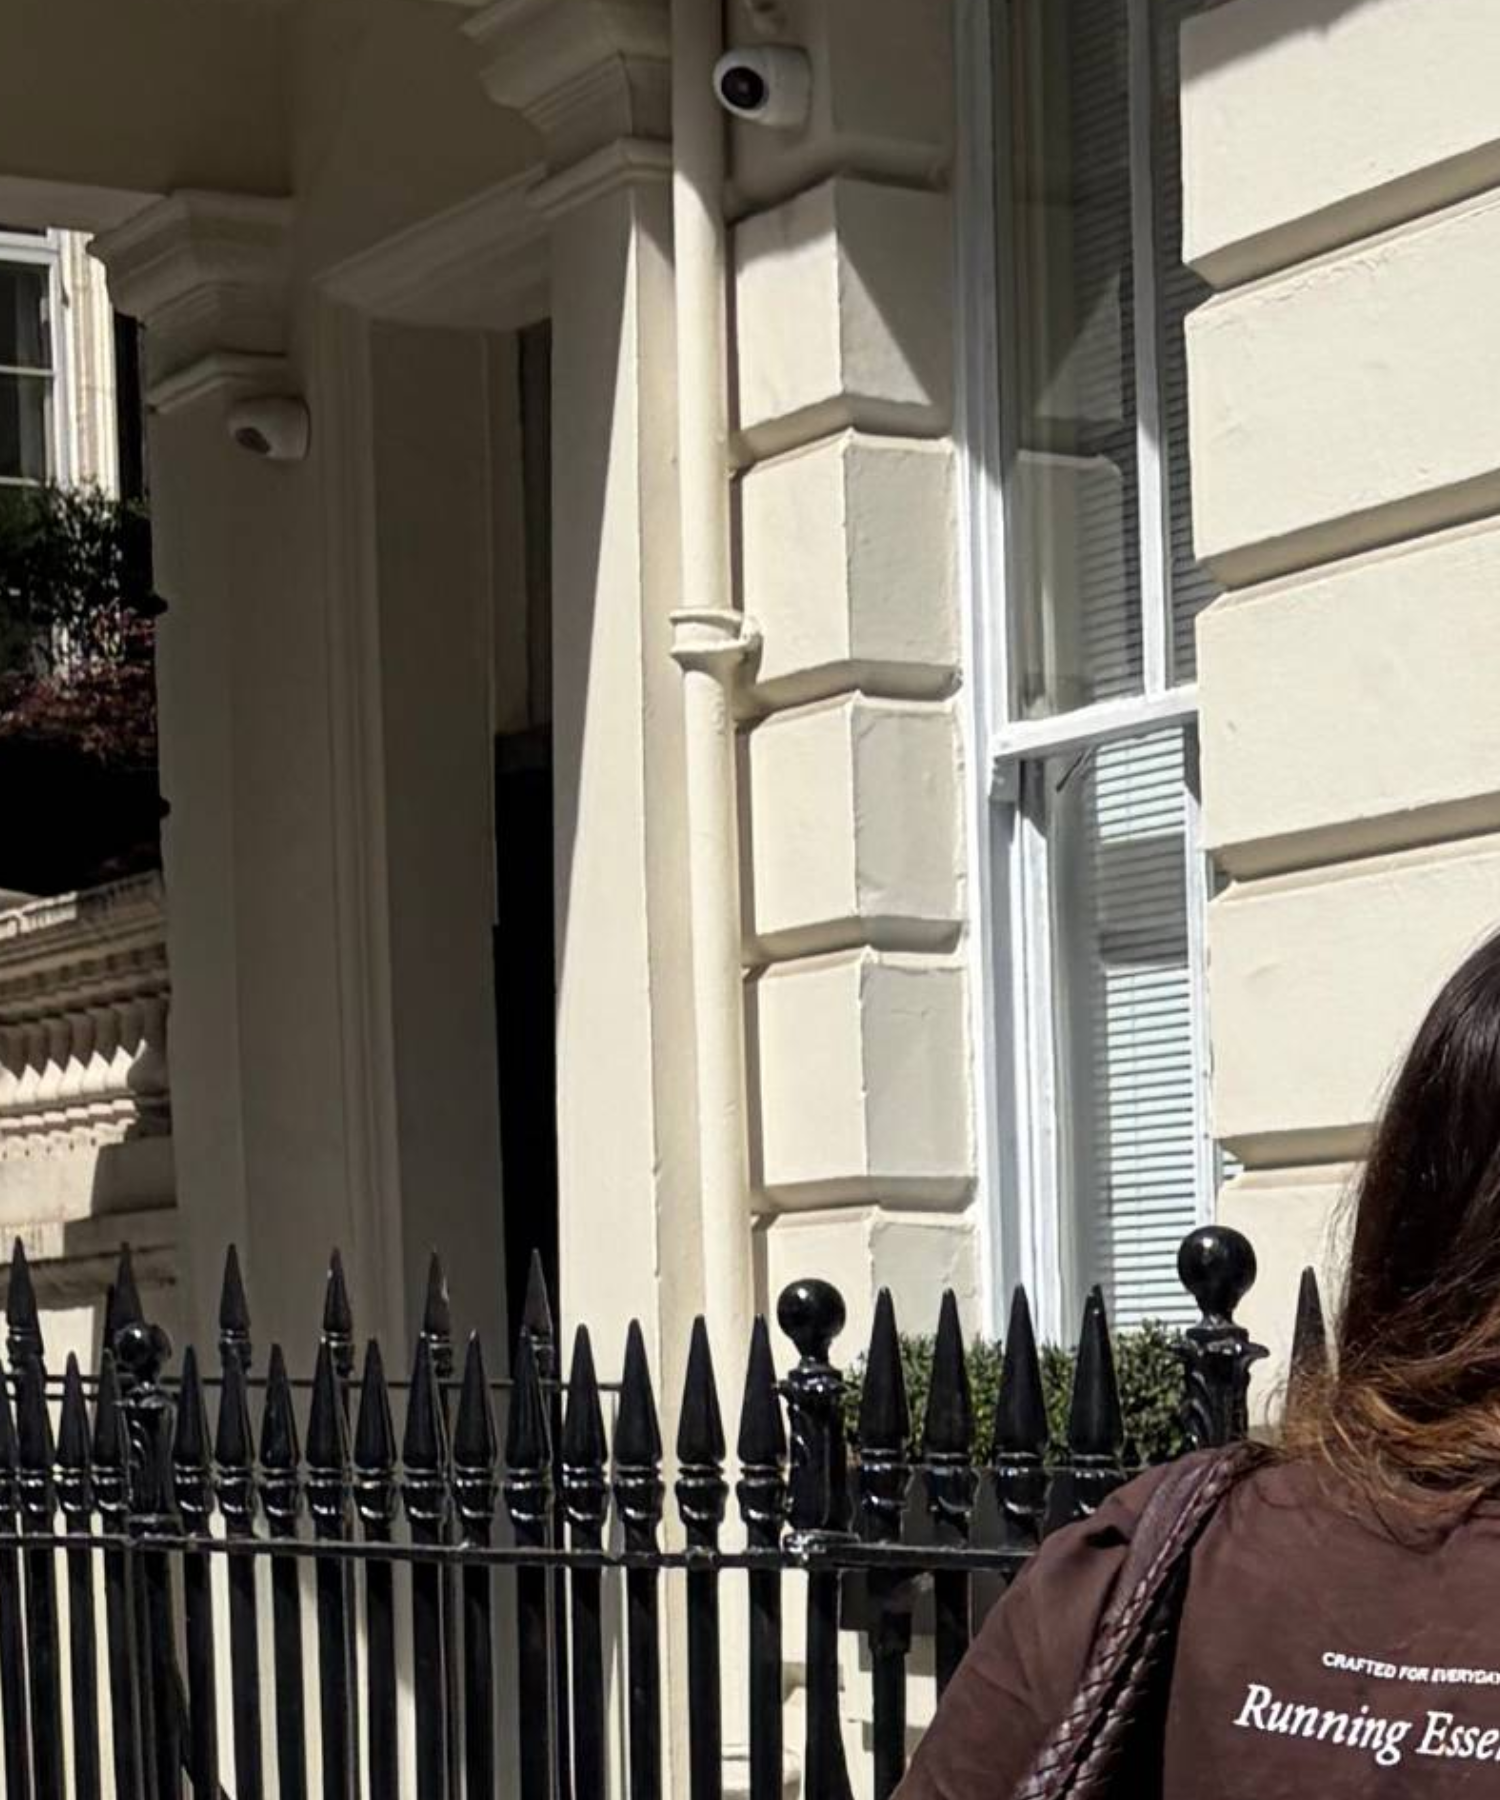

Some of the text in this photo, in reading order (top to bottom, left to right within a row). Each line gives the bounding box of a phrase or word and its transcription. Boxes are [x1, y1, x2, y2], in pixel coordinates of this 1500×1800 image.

[1322, 1651, 1397, 1679] CRAFTED
[1398, 1665, 1430, 1682] FOR
[1233, 1683, 1413, 1766] Running
